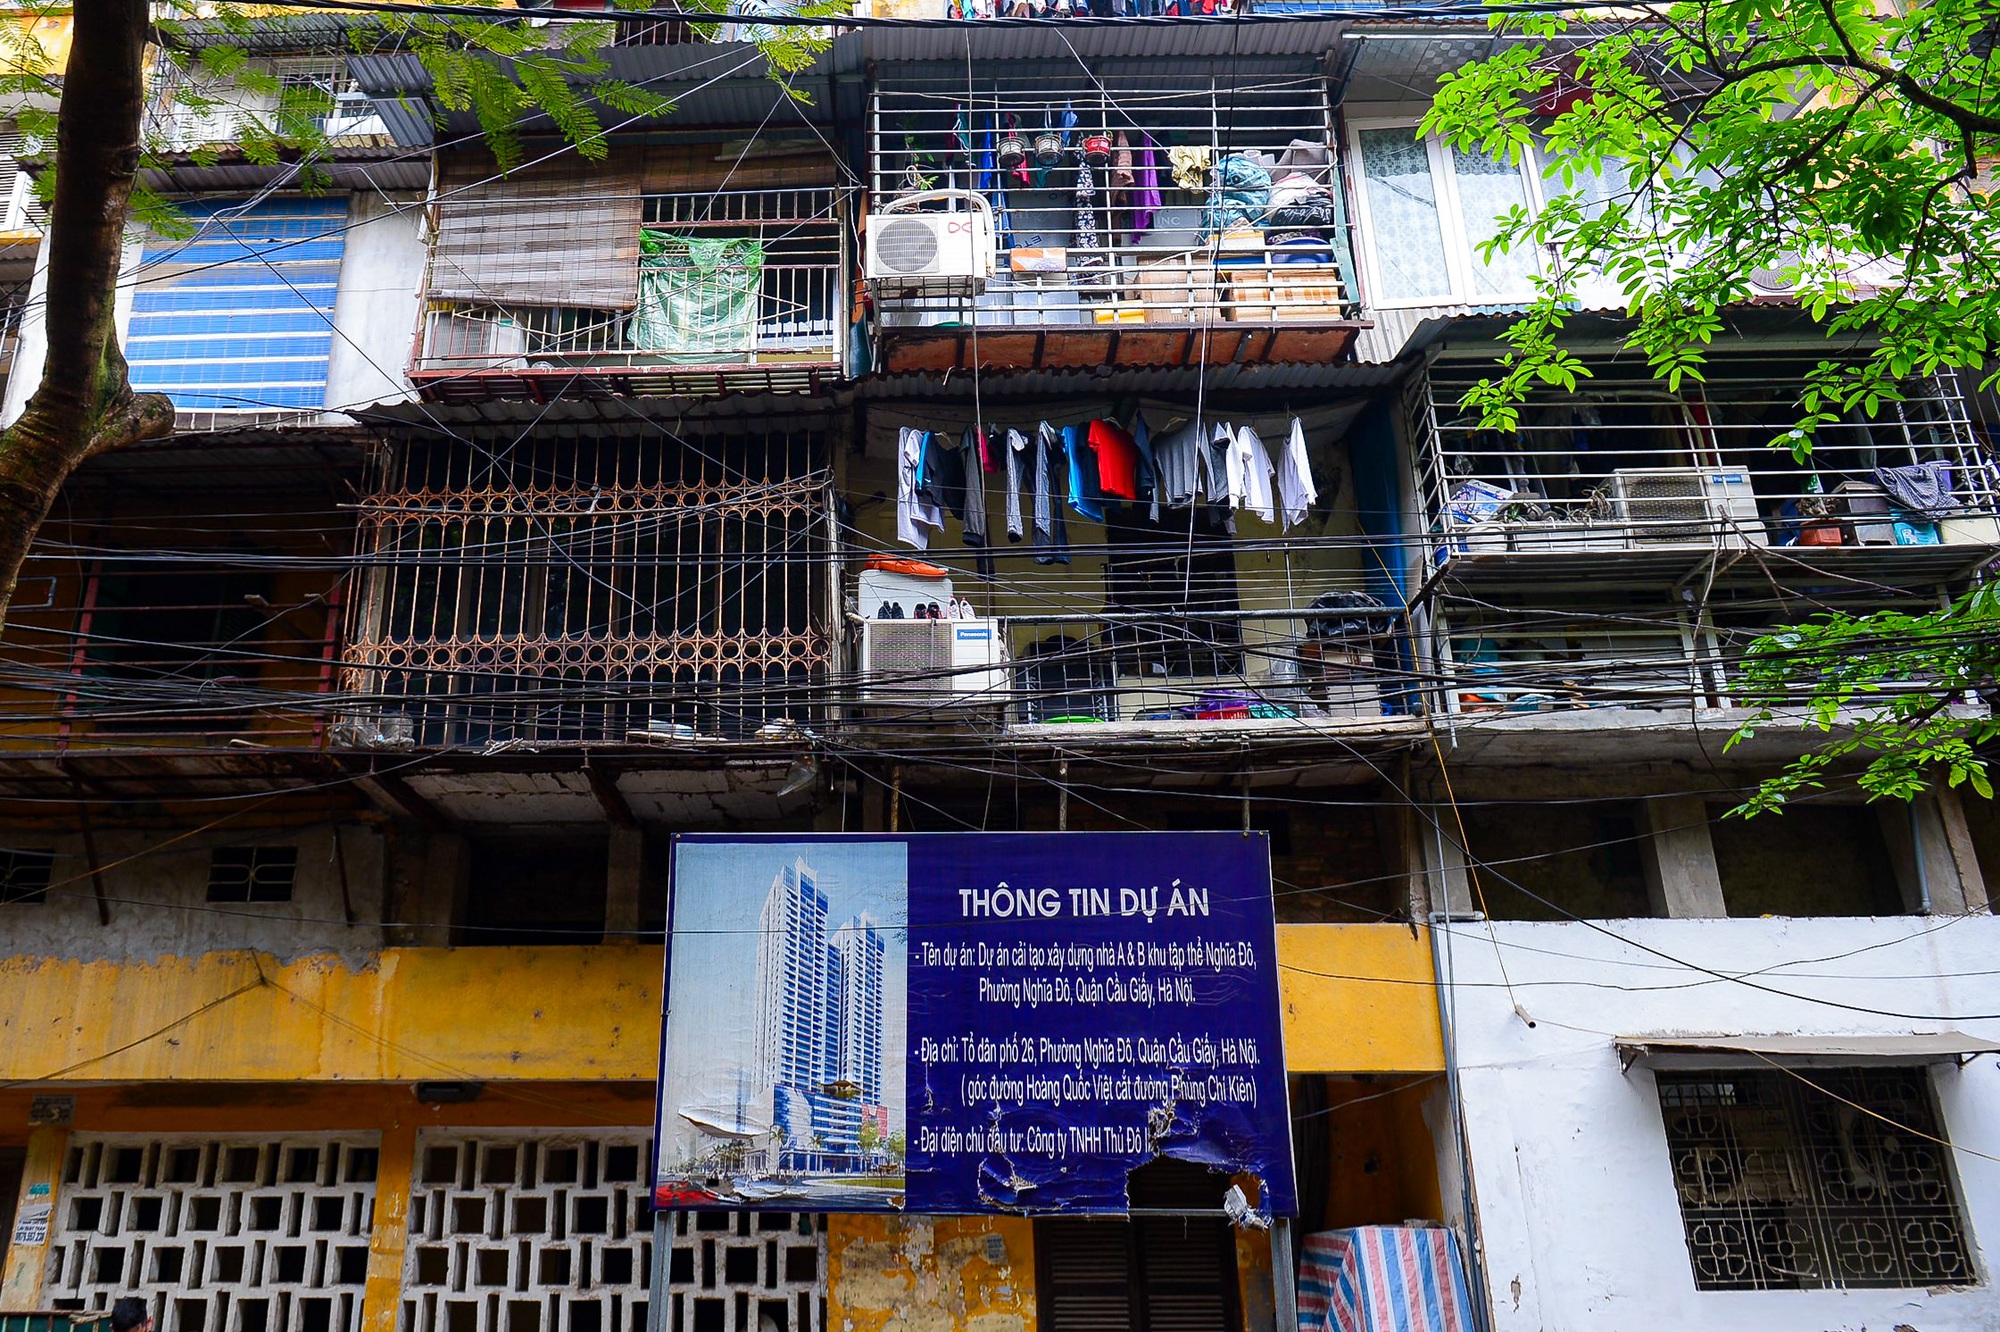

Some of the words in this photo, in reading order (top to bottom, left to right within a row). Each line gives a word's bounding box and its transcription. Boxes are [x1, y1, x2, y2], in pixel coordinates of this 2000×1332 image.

[959, 882, 1061, 917] THÔNG
[1069, 888, 1110, 916] TIN
[1120, 886, 1158, 923] DỰ
[1167, 878, 1209, 916] ÁN
[922, 942, 940, 966] Tên
[944, 942, 957, 971] dự
[960, 942, 975, 966] án:
[978, 942, 993, 971] Dự
[997, 942, 1009, 966] án
[1012, 941, 1026, 966] cải
[1029, 944, 1044, 971] tạo
[1047, 942, 1065, 972] xây
[1068, 942, 1093, 972] dựng
[1096, 942, 1114, 966] nhà
[1118, 942, 1125, 966] A
[1127, 942, 1134, 966] &
[1138, 942, 1145, 966] B
[1148, 942, 1166, 966] khu
[1169, 944, 1184, 972] tập
[1188, 936, 1202, 966] thể
[1206, 942, 1236, 972] Nghĩa
[1238, 942, 1256, 970] Đô,
[980, 978, 1020, 1008] Phường
[1023, 978, 1052, 1008] Nghĩa
[1055, 978, 1072, 1006] Đô,
[1076, 977, 1103, 1007] Quận
[1106, 972, 1126, 1002] Cầu
[1130, 972, 1155, 1008] Giấy,
[1158, 977, 1172, 1002] Hà
[1176, 978, 1195, 1007] Nội.
[921, 1038, 938, 1067] Địa
[941, 1036, 958, 1062] chỉ:
[961, 1031, 974, 1062] Tổ
[978, 1038, 996, 1062] dân
[1000, 1032, 1018, 1068] phố
[1021, 1038, 1037, 1066] 26,
[1040, 1038, 1081, 1069] Phường
[1084, 1038, 1114, 1069] Nghĩa
[1117, 1038, 1135, 1067] Đô,
[1138, 1038, 1166, 1067] Quận
[1169, 1032, 1189, 1063] Cầu
[1192, 1032, 1219, 1070] Giấy,
[1221, 1038, 1236, 1063] Hà
[1239, 1038, 1260, 1069] Nội.
[968, 1074, 987, 1106] góc
[990, 1074, 1023, 1106] đường
[1027, 1074, 1060, 1106] Hoàng
[1063, 1069, 1091, 1100] Quốc
[1092, 1075, 1113, 1105] Việt
[1116, 1069, 1131, 1100] cắt
[1134, 1075, 1168, 1106] đường
[1171, 1075, 1205, 1107] Phùng
[1208, 1075, 1226, 1101] Chí
[1229, 1075, 1256, 1108] Kiên)
[921, 1126, 938, 1157] Đại
[941, 1126, 962, 1157] diện
[966, 1125, 984, 1152] chủ
[1010, 1128, 1023, 1152] tư:
[1027, 1126, 1054, 1159] Công
[1058, 1128, 1067, 1159] ty
[1069, 1126, 1101, 1153] TNHH
[1104, 1126, 1123, 1153] Thủ
[1127, 1126, 1141, 1154] Đô
